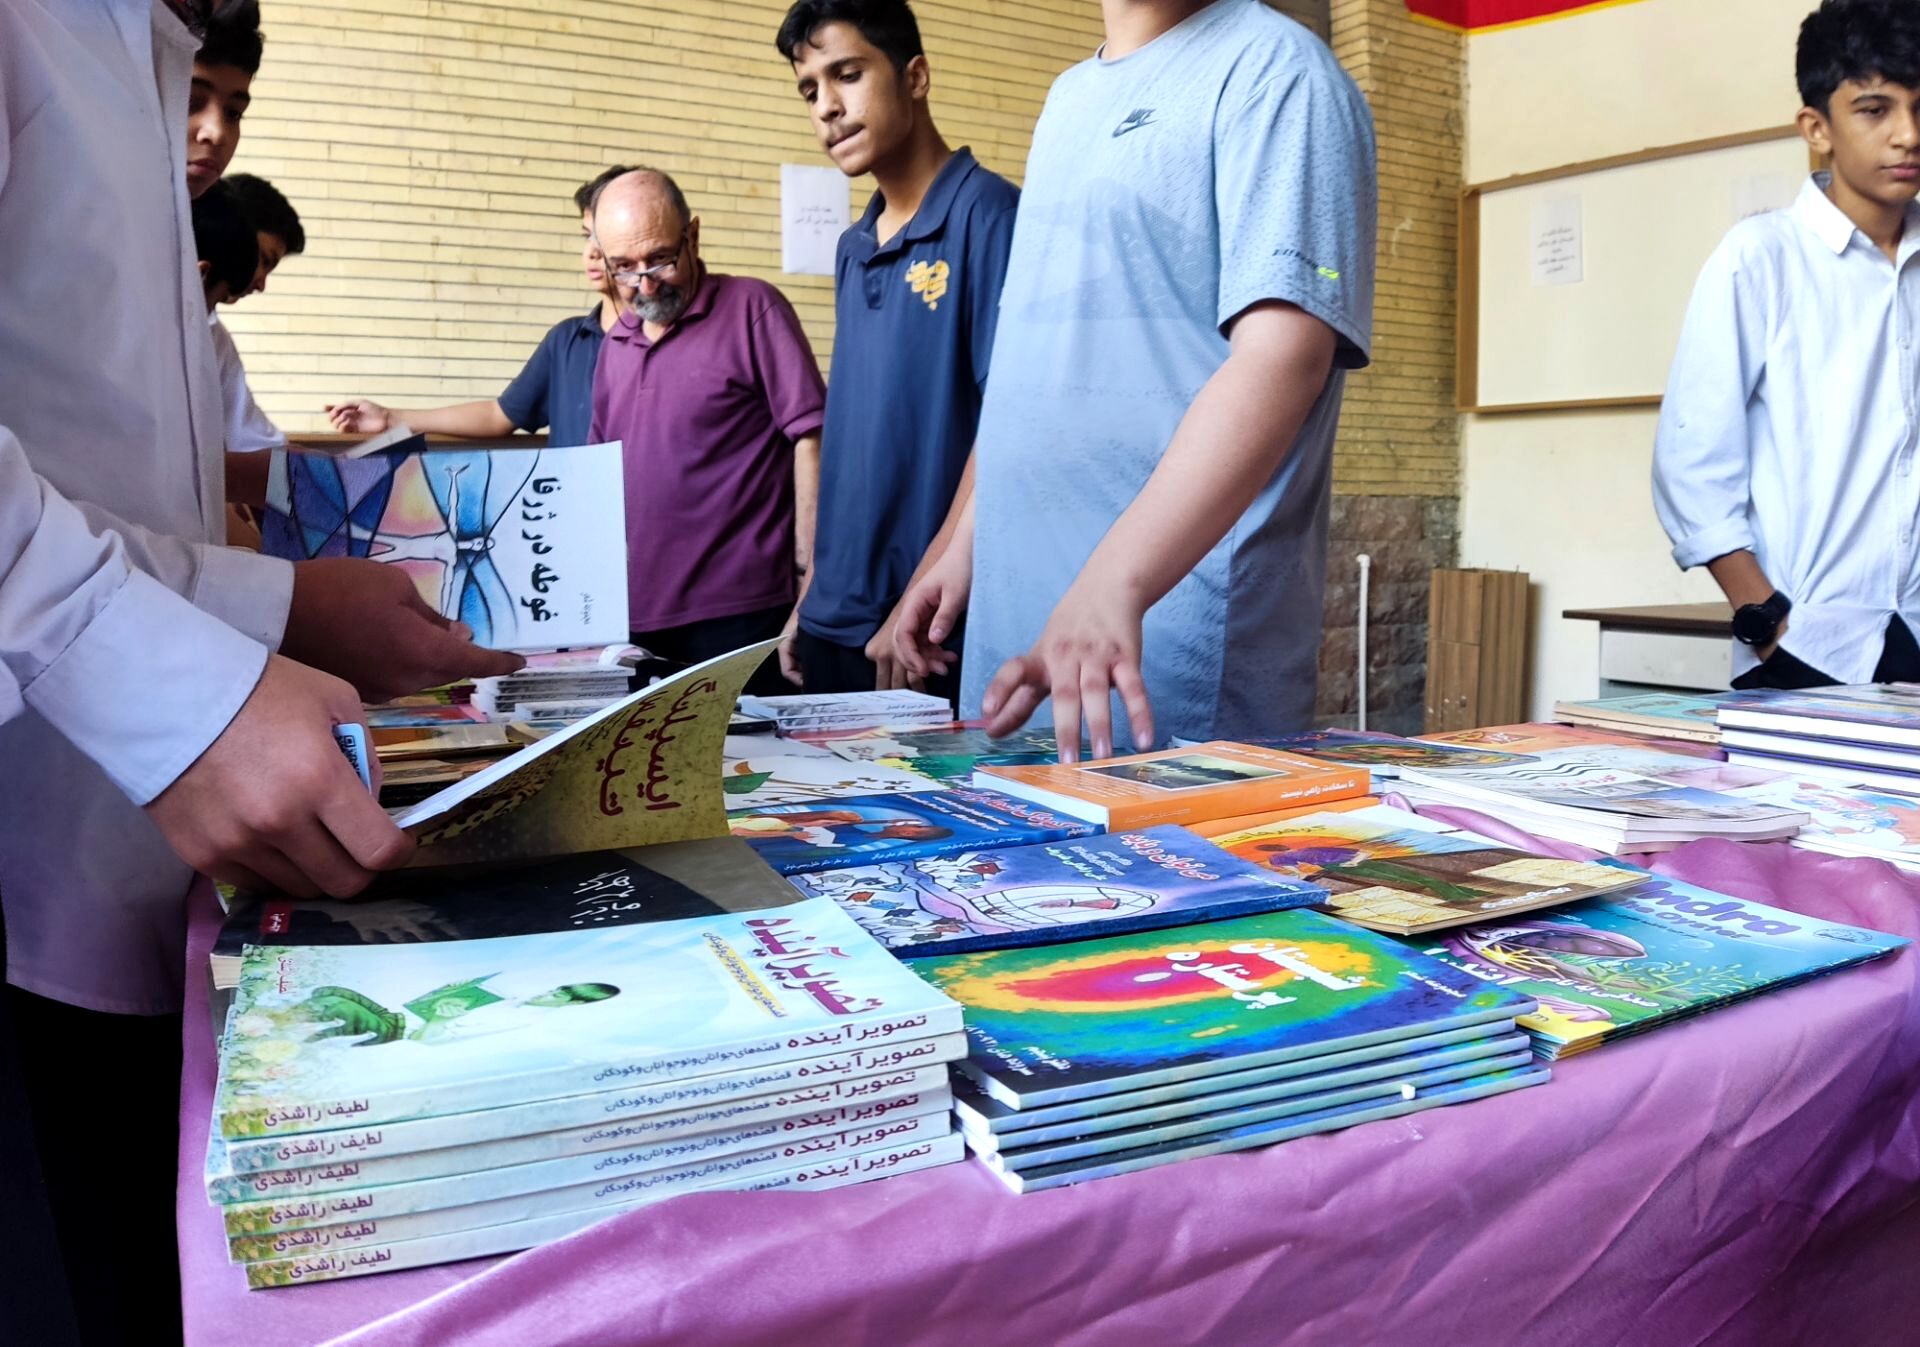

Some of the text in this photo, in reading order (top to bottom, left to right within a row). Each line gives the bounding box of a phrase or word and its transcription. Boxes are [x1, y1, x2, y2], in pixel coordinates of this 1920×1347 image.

[521, 477, 562, 622] غوطه در ژرفا
[787, 1025, 853, 1049] آینده
[858, 1015, 928, 1043] تصویر
[798, 1052, 863, 1078] آینده
[868, 1042, 937, 1069] تصویر
[776, 1081, 842, 1107] آینده
[848, 1070, 917, 1098] تصویر
[264, 1098, 371, 1127] لطیف راشدی
[783, 1105, 848, 1132] آینده
[850, 1094, 920, 1122] تصویر
[276, 1131, 383, 1161] لطیف راشدی
[783, 1131, 848, 1157] آینده
[850, 1118, 919, 1146] تصویر
[796, 1157, 861, 1183] آینده
[863, 1143, 932, 1171] تصویر
[254, 1162, 360, 1192] لطیف راشدی
[269, 1194, 374, 1224] لطیف راشدی
[272, 1221, 377, 1251] لطیف راشدی
[288, 1248, 392, 1279] لطیف راشدی
